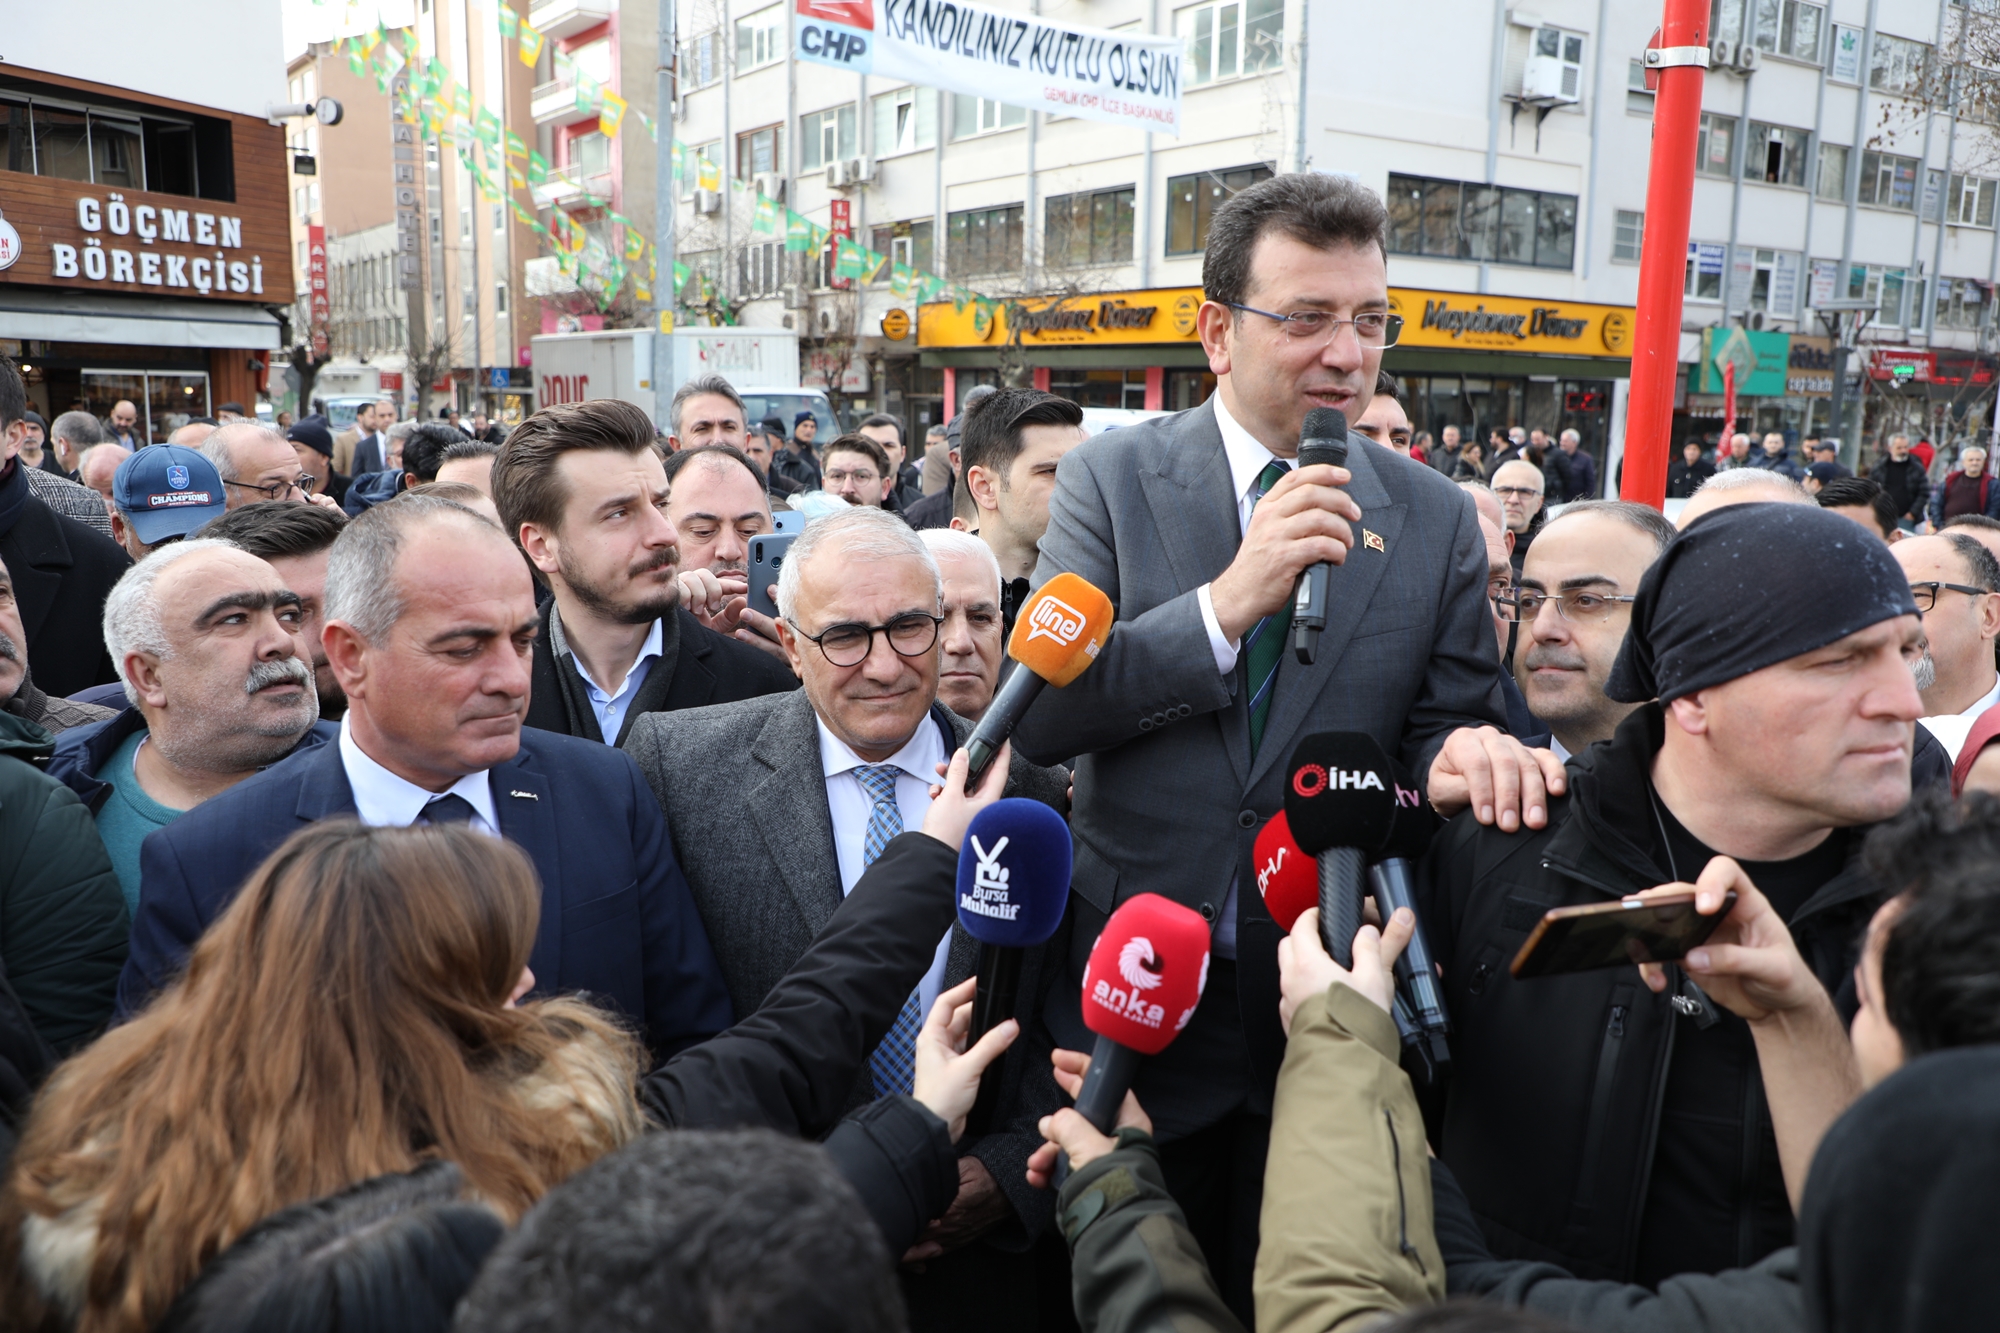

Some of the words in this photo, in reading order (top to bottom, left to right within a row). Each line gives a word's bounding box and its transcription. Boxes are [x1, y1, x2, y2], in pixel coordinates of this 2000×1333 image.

[801, 26, 867, 63] CHP
[1029, 25, 1105, 83] KUTLU
[1109, 43, 1178, 99] OLSUN
[77, 192, 242, 249] GÖÇMEN
[399, 165, 419, 275] HOTEL
[52, 236, 264, 294] BÖREKÇİSİ
[1098, 300, 1157, 328] Döner
[1422, 299, 1527, 339] Maydonoz
[1530, 308, 1588, 339] Döner
[151, 493, 209, 505] CHAMPIONS
[1035, 601, 1078, 637] line
[1329, 766, 1386, 790] İHA
[960, 893, 1021, 921] Muhalif
[972, 884, 1009, 903] Bursa
[1094, 979, 1165, 1022] anka
